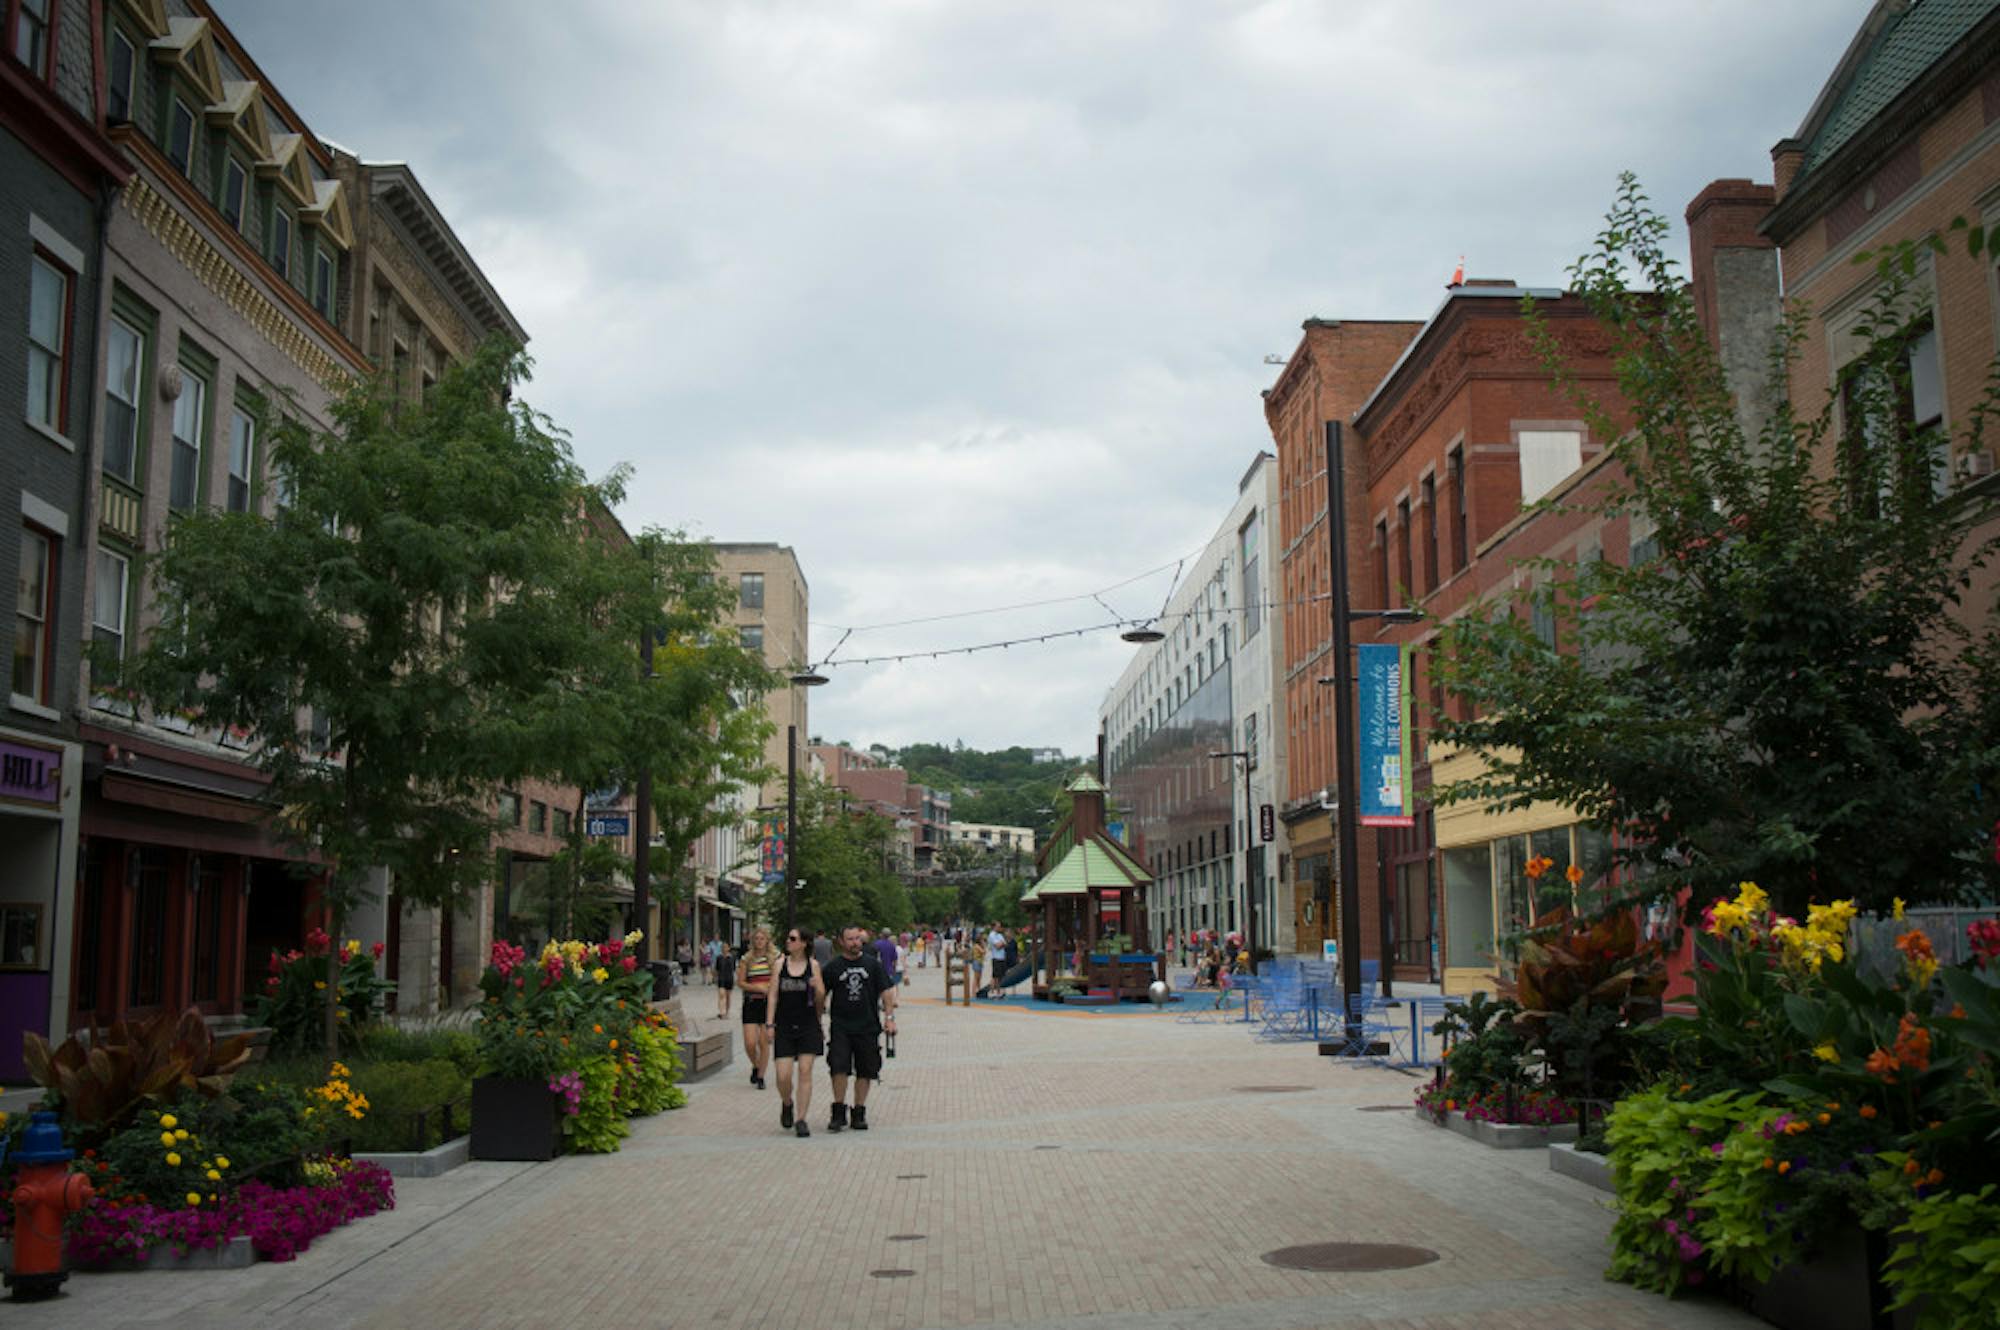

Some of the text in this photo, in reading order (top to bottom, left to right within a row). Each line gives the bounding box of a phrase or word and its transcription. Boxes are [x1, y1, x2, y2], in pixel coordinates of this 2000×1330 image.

[1370, 664, 1385, 747] Welcome to
[1387, 664, 1401, 748] THE COMMONS
